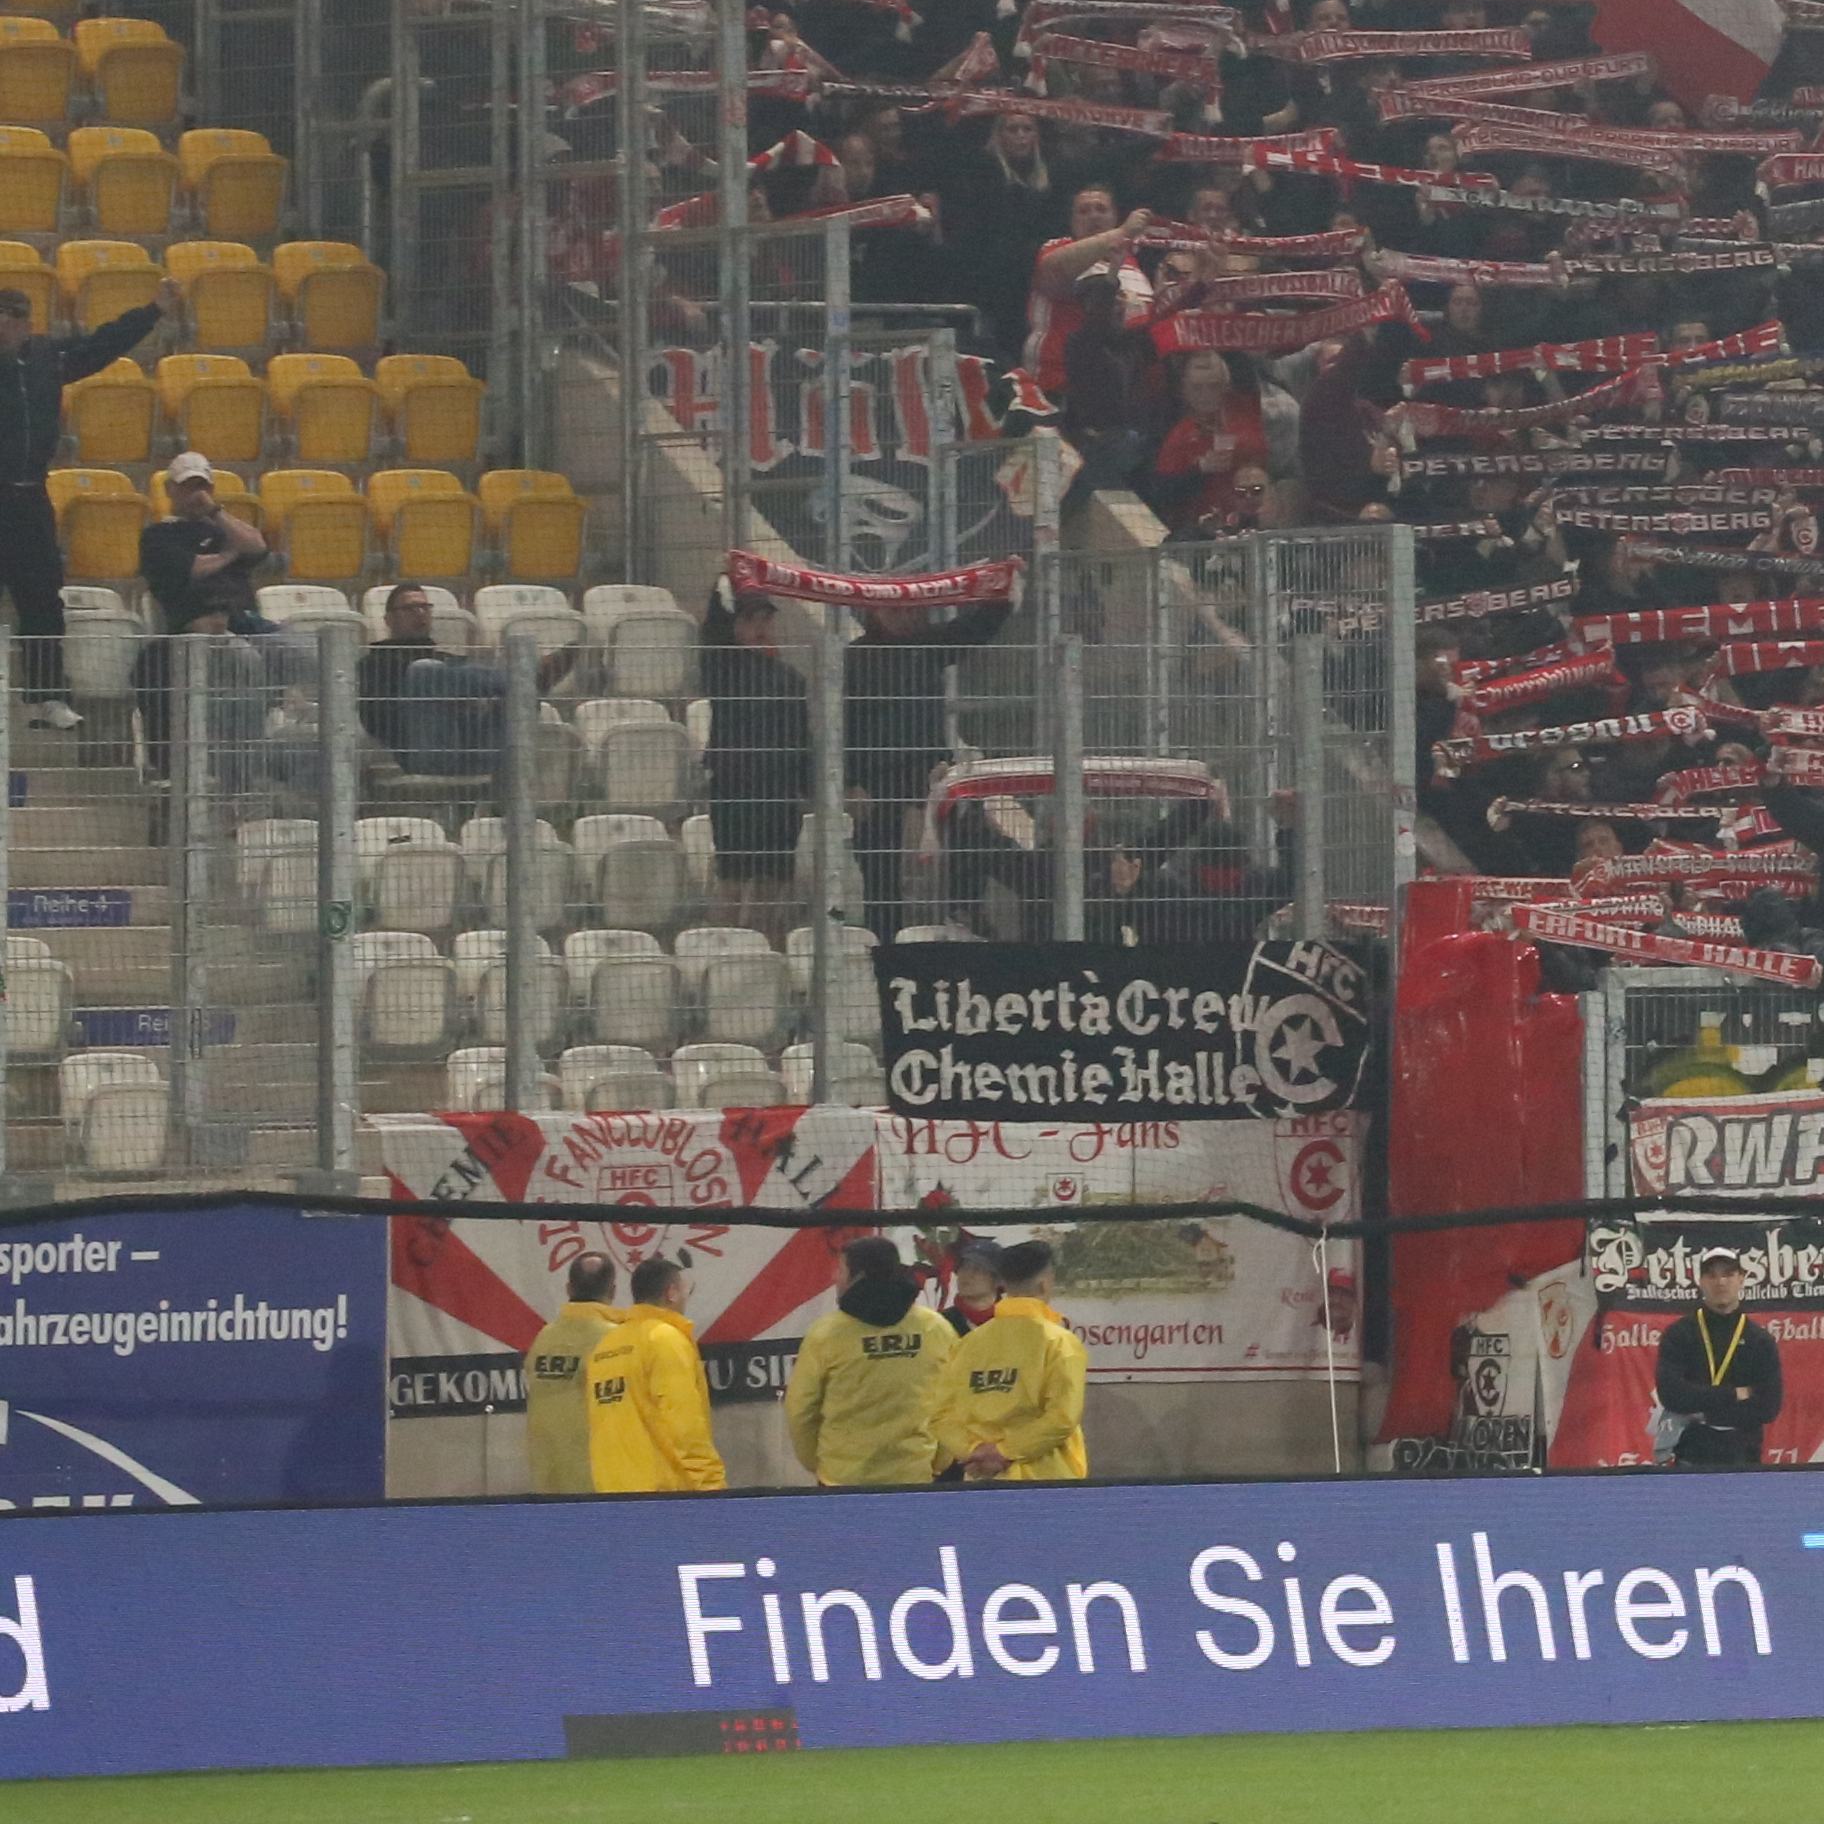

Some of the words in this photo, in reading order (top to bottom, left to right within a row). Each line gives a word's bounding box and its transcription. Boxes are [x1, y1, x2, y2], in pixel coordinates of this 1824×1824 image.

[1401, 453, 1667, 477] PETERSBERG
[1556, 509, 1773, 531] PETERSBERG
[1286, 943, 1359, 1003] HFC
[1527, 909, 1646, 953] ERFURT
[1703, 944, 1801, 983] HALLE
[889, 970, 1113, 1037] Libertà
[1116, 979, 1268, 1037] Crew
[891, 1043, 1113, 1106] Chemie
[1113, 1046, 1264, 1106] Halle
[610, 1167, 659, 1188] HFC
[1475, 1337, 1505, 1353] HFC
[676, 1544, 1148, 1688] Finden
[1193, 1542, 1393, 1673] Sie
[1434, 1530, 1773, 1664] Ihren
